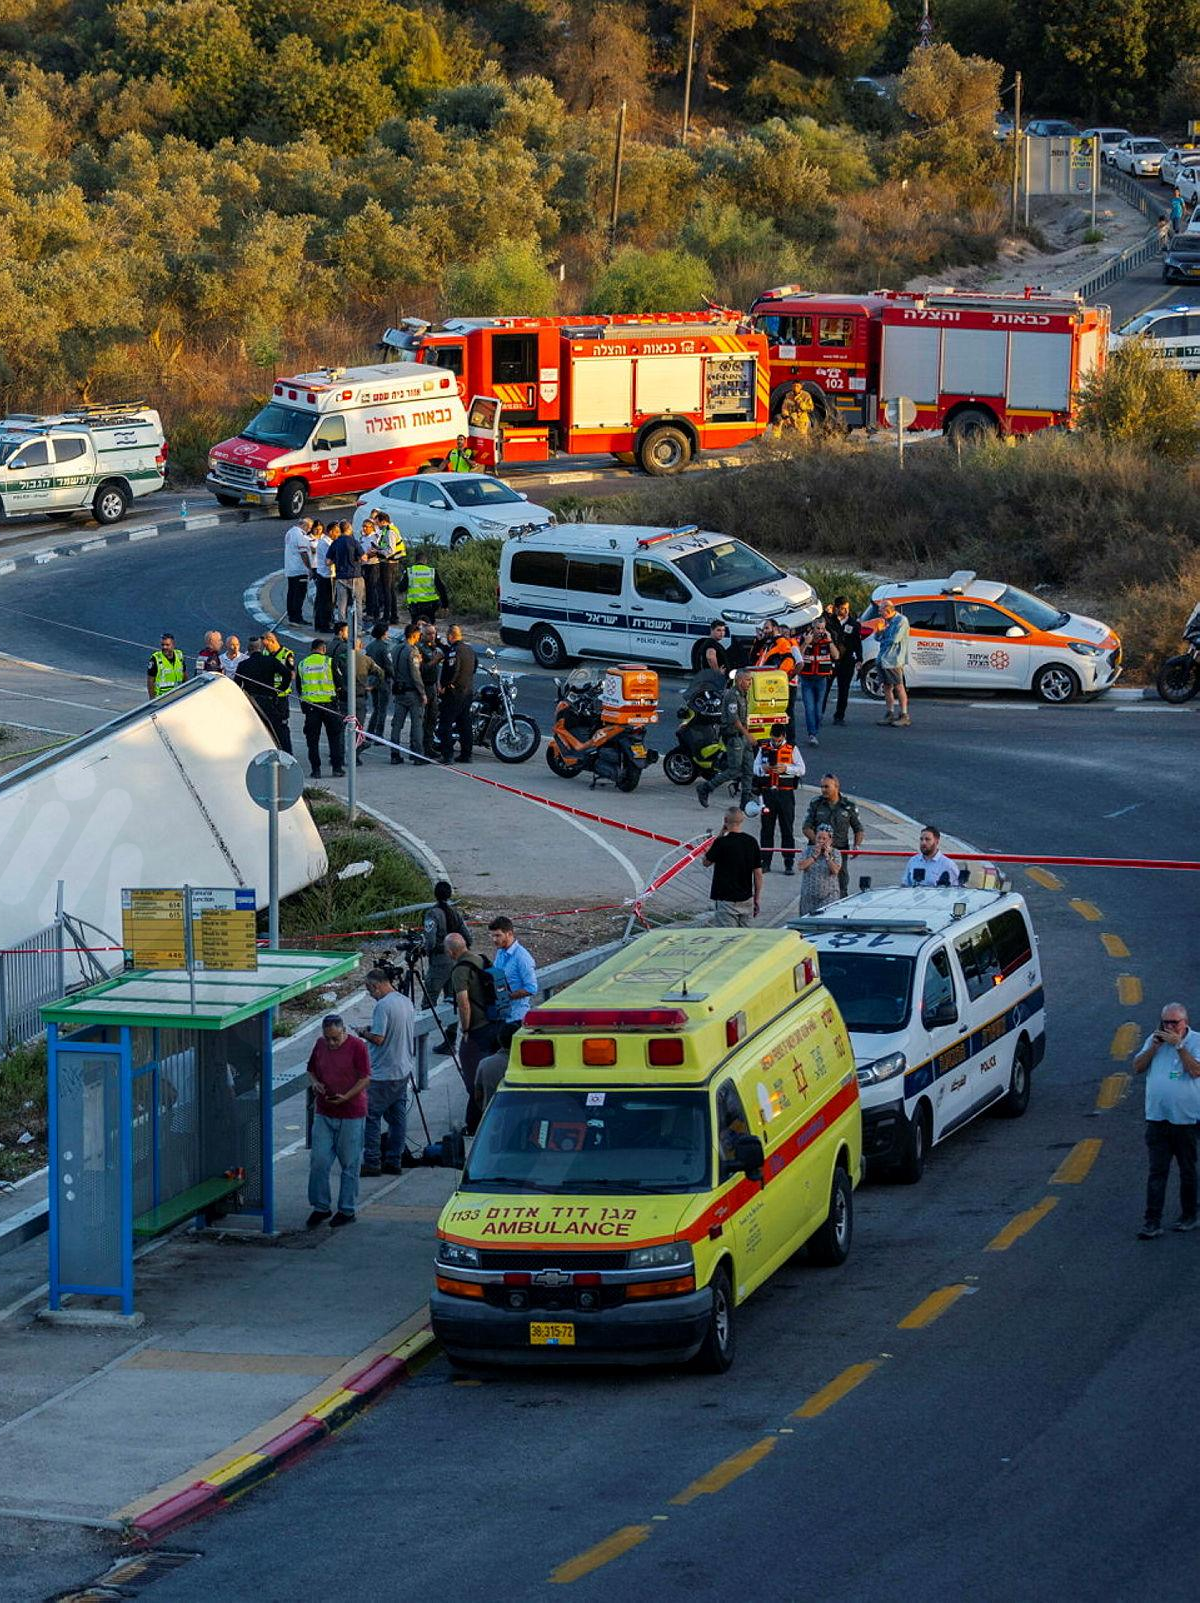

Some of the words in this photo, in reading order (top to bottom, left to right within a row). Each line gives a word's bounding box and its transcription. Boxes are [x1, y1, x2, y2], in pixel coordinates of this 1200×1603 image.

[904, 309, 961, 321] והצלה
[992, 313, 1051, 325] כבאות
[593, 344, 627, 356] והצלה
[643, 342, 677, 354] כבאות
[825, 378, 844, 389] 102
[412, 407, 452, 428] כבאות
[365, 414, 407, 434] והצלה
[19, 479, 50, 490] הגבול
[57, 476, 88, 486] משמר
[586, 613, 618, 624] ישראל
[632, 618, 672, 630] משטרת
[486, 1206, 540, 1219] אדום
[552, 1206, 592, 1219] דוד
[600, 1208, 637, 1221] מגן
[481, 1221, 632, 1237] AMBULANCE
